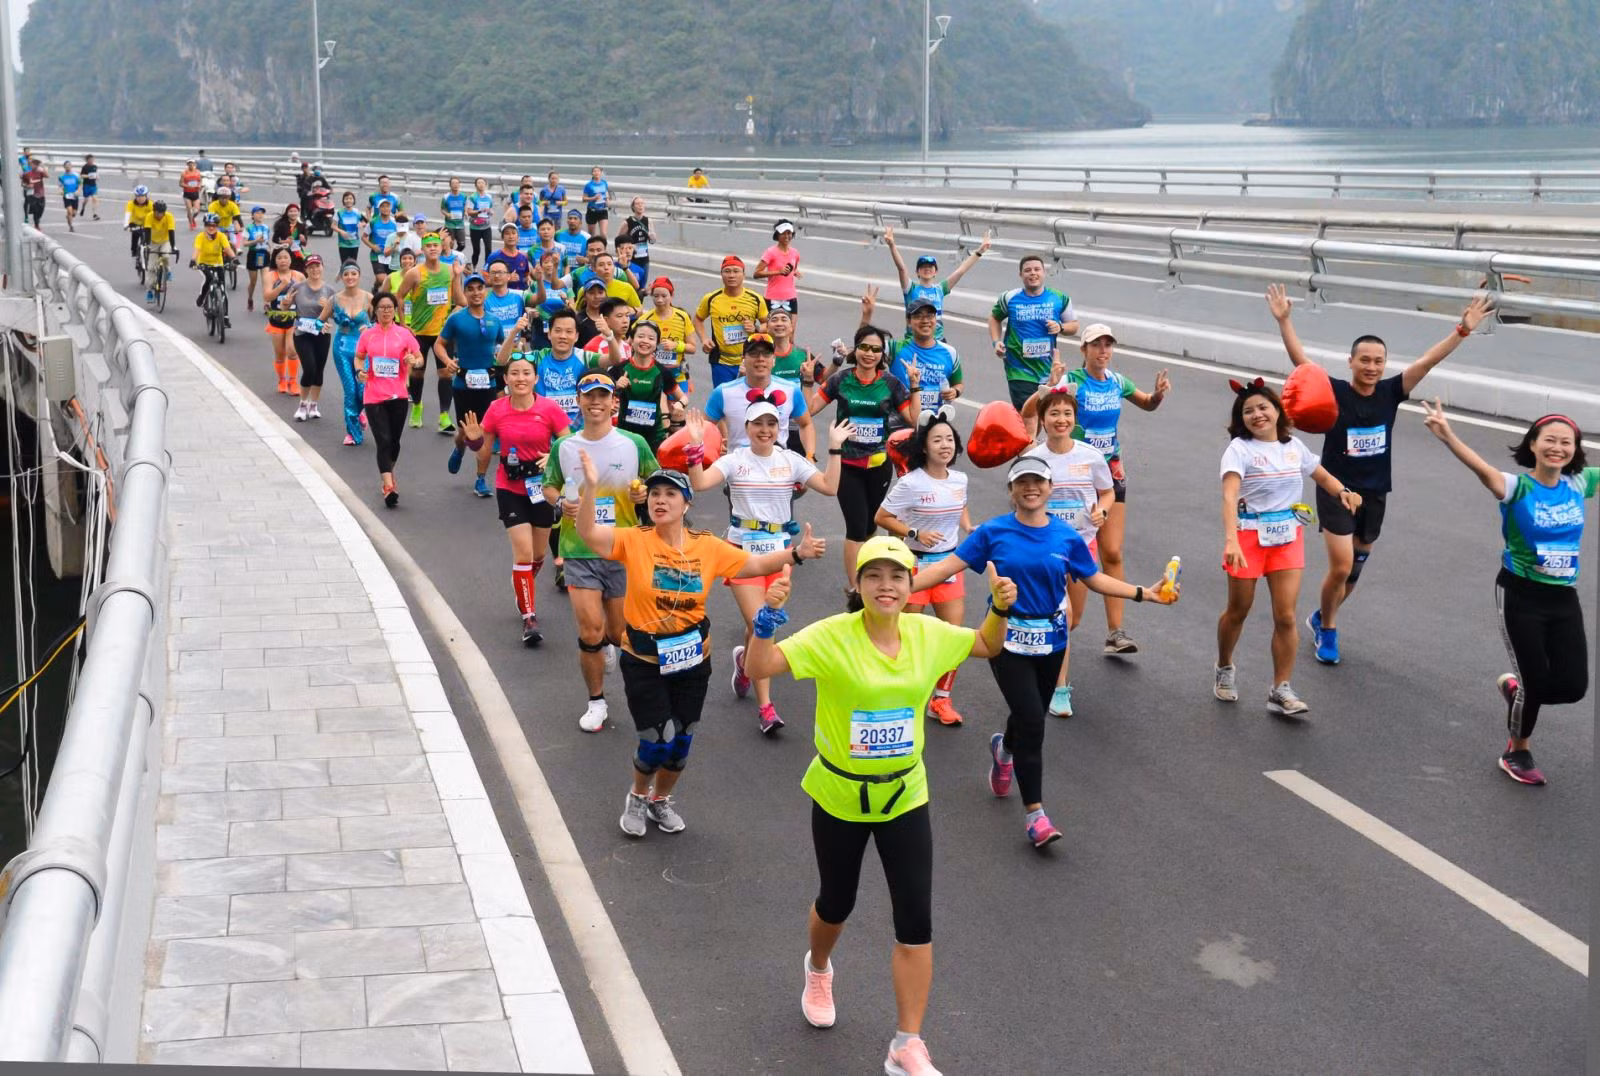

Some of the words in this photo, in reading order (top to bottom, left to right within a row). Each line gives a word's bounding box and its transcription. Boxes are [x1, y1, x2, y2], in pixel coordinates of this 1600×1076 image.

[1016, 307, 1054, 315] HERITAGE
[1353, 437, 1381, 449] 20547
[1055, 512, 1075, 520] ACER
[1266, 524, 1289, 534] PACER
[750, 543, 775, 553] PACER
[1010, 630, 1046, 645] 20423
[665, 645, 697, 665] 20422
[860, 726, 904, 744] 20337
